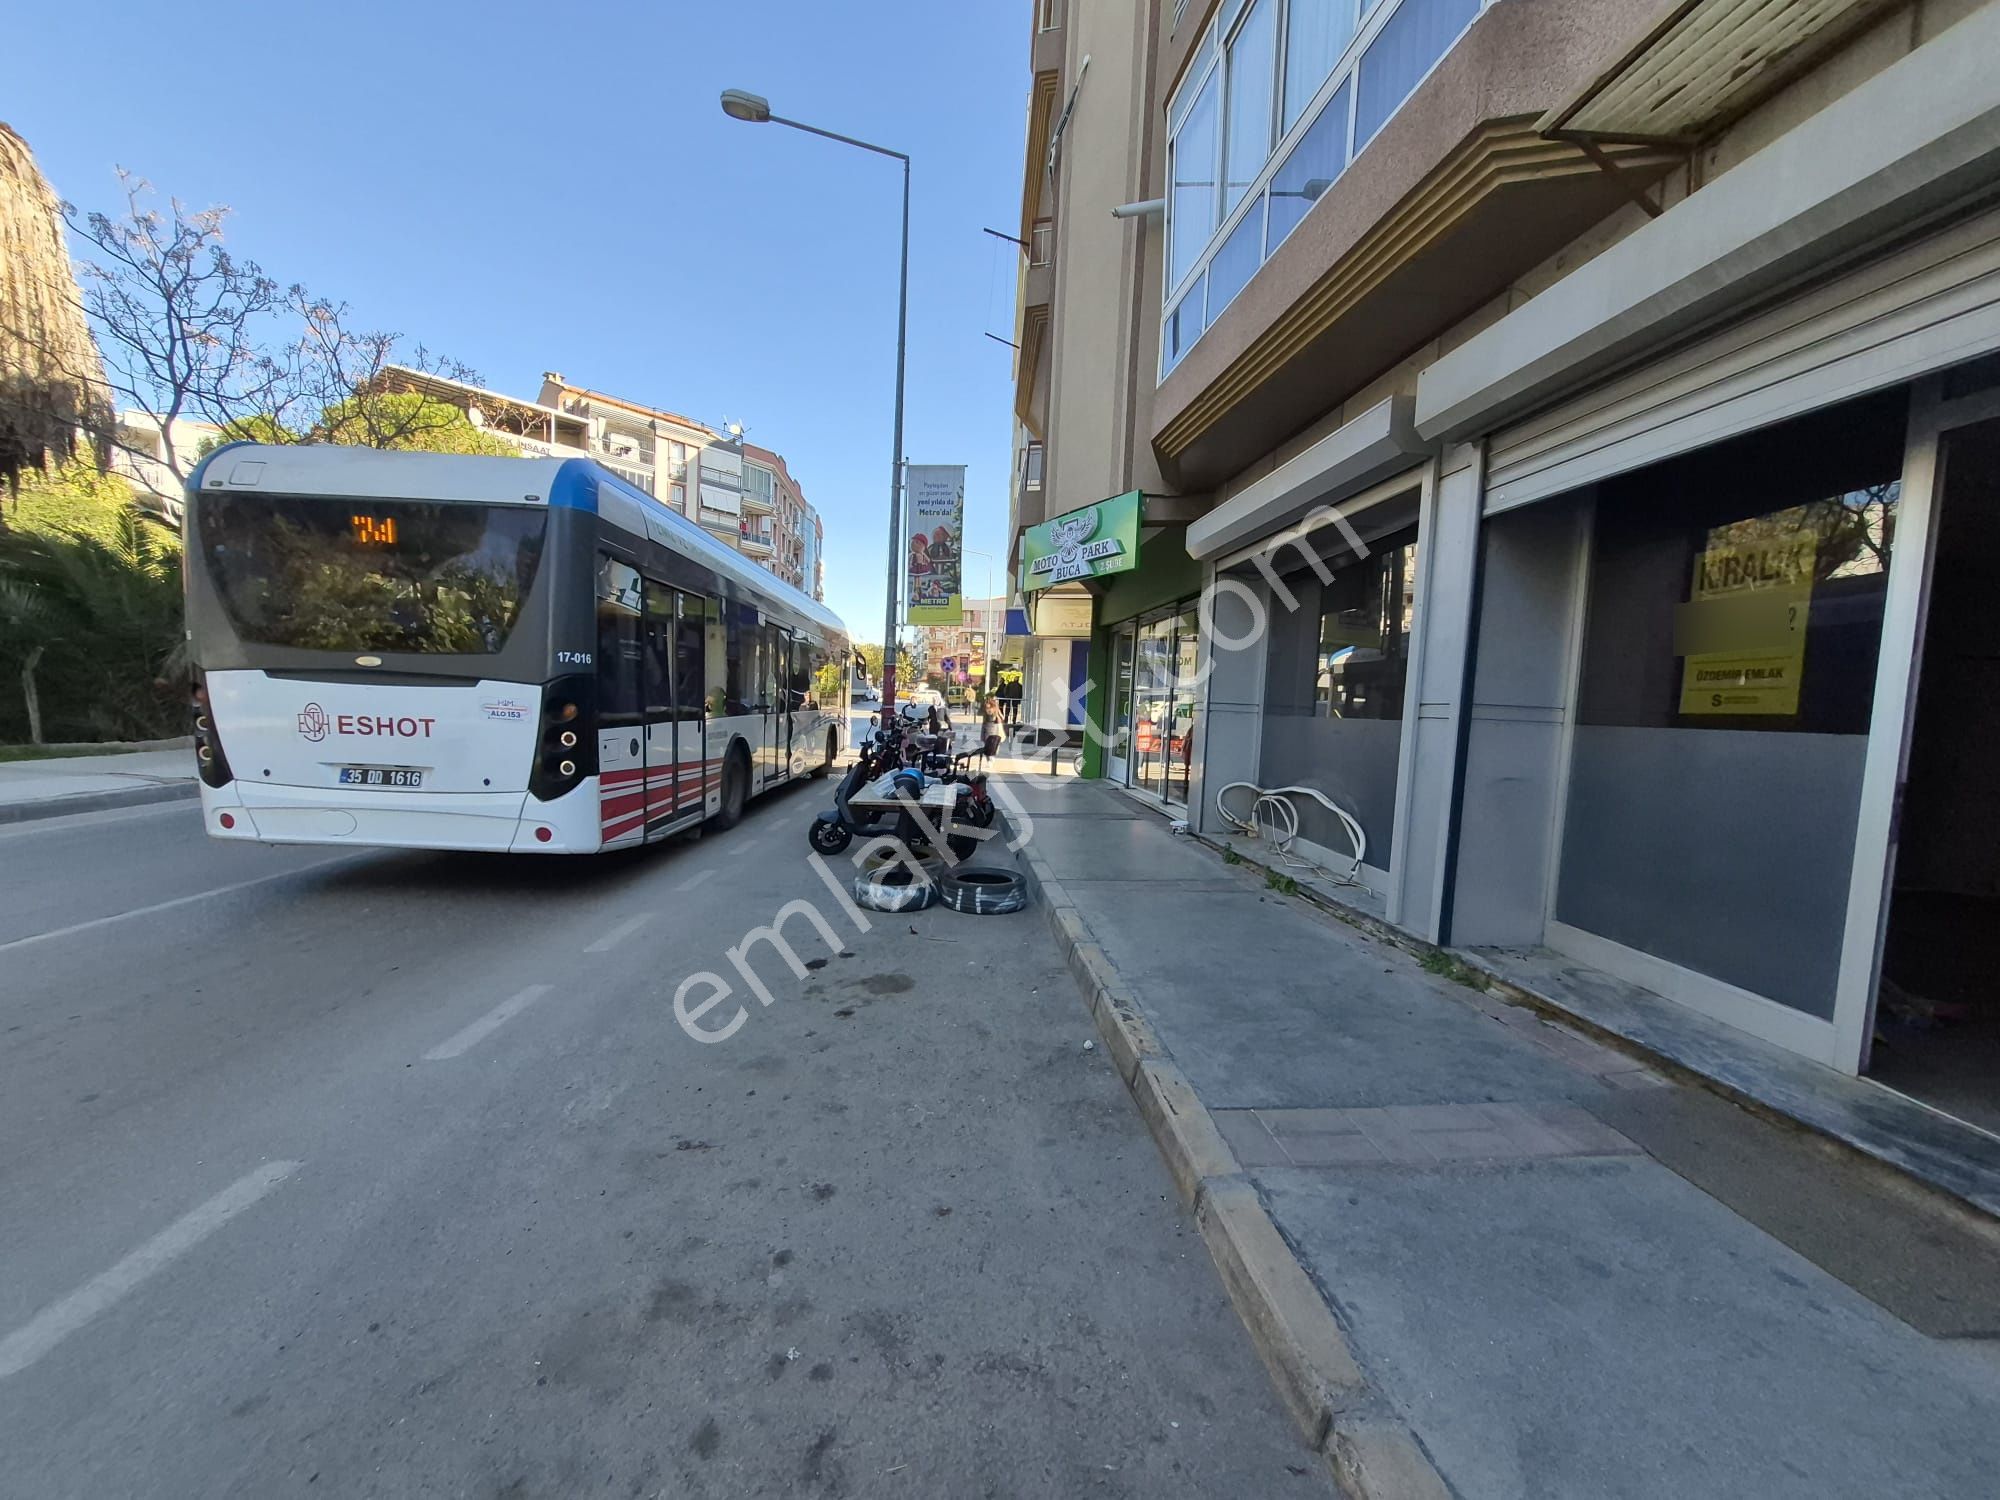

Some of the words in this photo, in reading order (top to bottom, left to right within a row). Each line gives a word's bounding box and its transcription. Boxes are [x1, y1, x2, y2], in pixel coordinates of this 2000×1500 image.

[1033, 555, 1058, 571] MOTO
[1081, 541, 1110, 559] PARK
[1056, 564, 1081, 579] BUCA
[557, 651, 592, 664] 17-016
[507, 711, 521, 719] 153
[337, 715, 436, 738] ESHOT
[346, 769, 363, 783] 35
[390, 771, 420, 786] 1616
